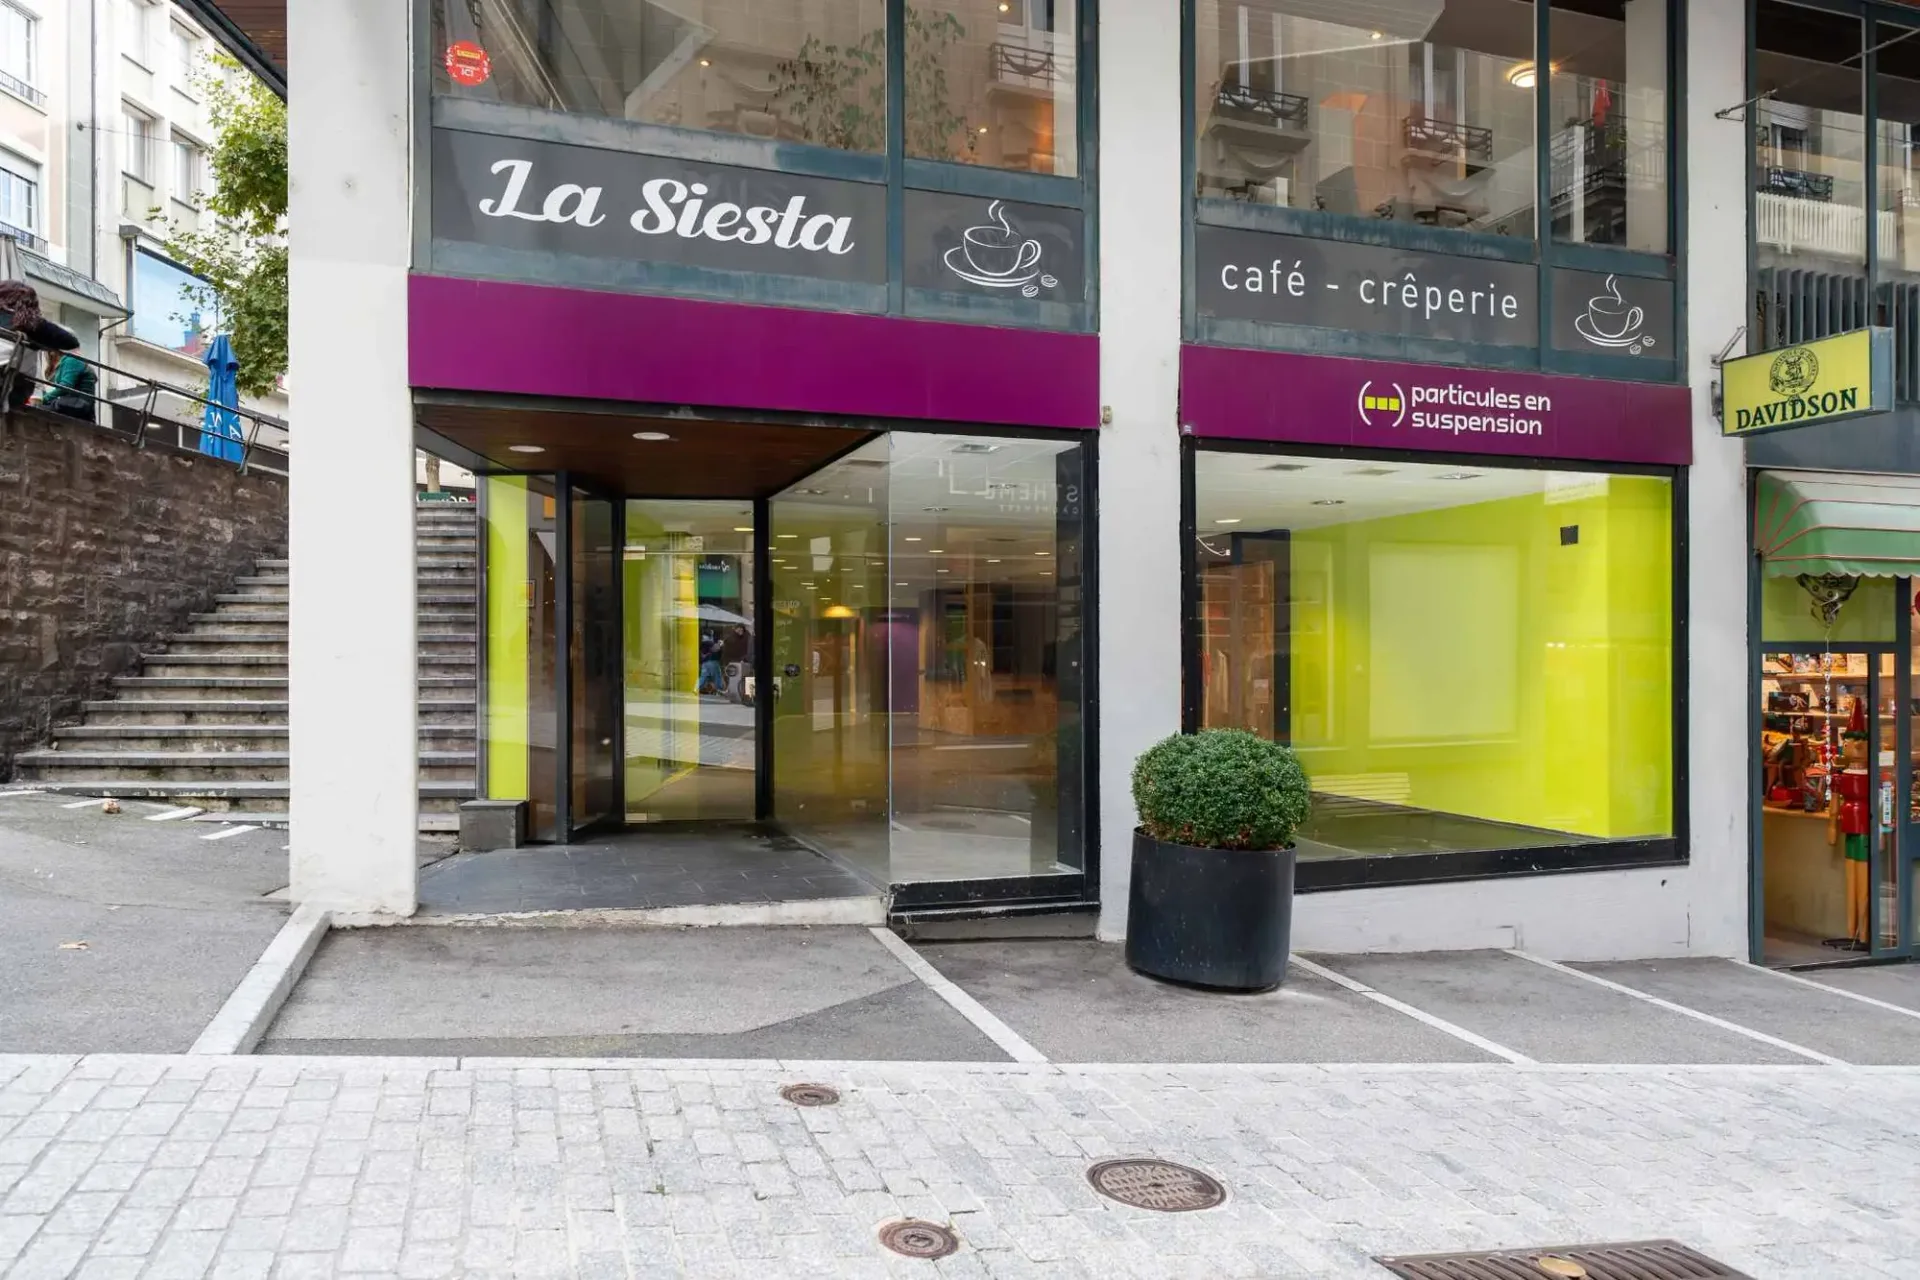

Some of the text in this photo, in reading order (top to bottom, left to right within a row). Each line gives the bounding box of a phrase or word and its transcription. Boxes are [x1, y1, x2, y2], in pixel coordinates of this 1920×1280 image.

[479, 159, 854, 254] La Siesta
[1221, 260, 1305, 296] café
[1359, 272, 1518, 320] crêperie
[1411, 384, 1552, 411] particules en
[1736, 387, 1858, 430] DAVIDSON
[1411, 411, 1543, 435] suspension
